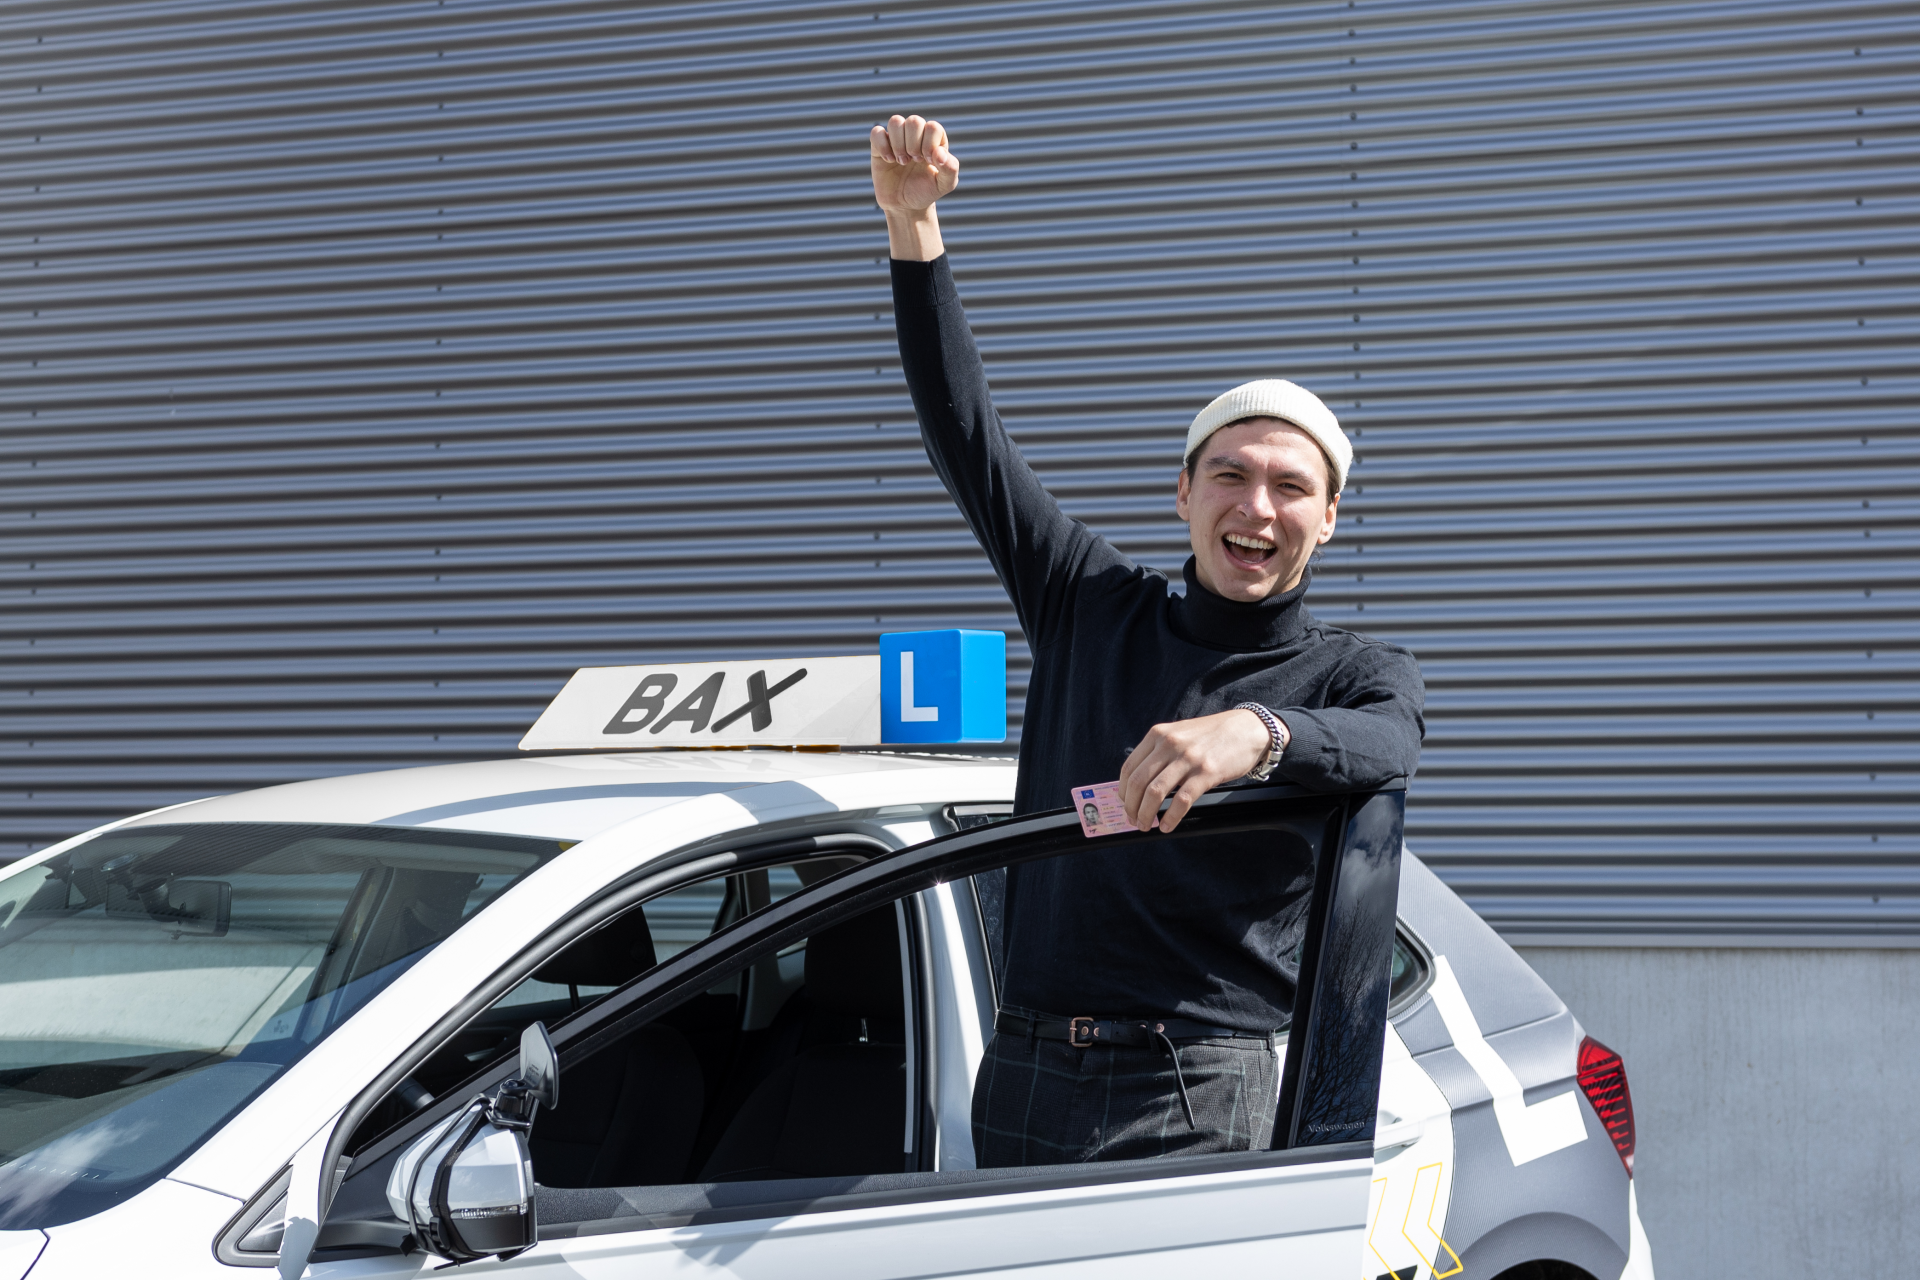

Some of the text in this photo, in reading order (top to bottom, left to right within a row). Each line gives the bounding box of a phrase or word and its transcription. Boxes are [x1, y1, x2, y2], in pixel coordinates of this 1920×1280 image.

[602, 668, 807, 734] BAX
[900, 651, 938, 722] L
[1308, 1121, 1366, 1133] Volkswagen
